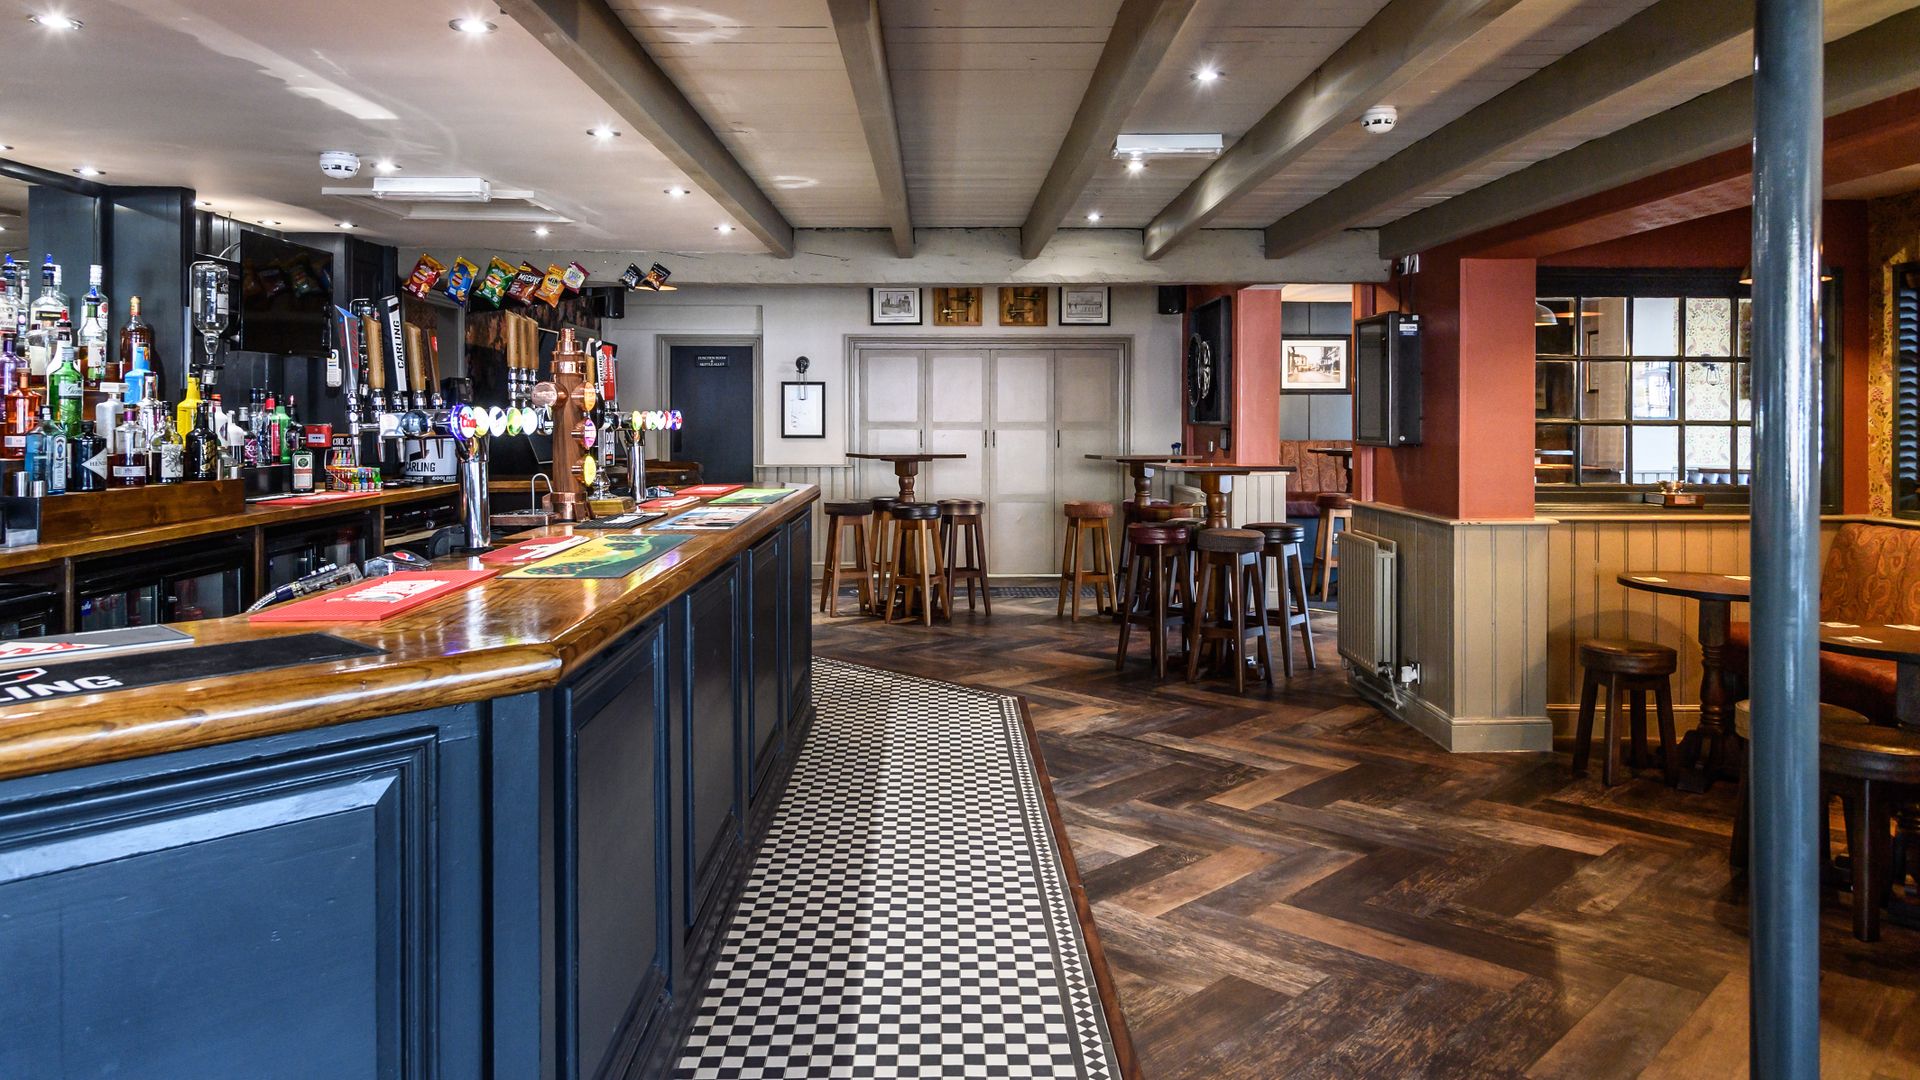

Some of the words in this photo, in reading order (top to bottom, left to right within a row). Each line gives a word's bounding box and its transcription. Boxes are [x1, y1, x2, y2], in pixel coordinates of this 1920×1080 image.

[393, 320, 405, 369] CARLING
[332, 437, 345, 445] COOL
[0, 675, 124, 702] ING
